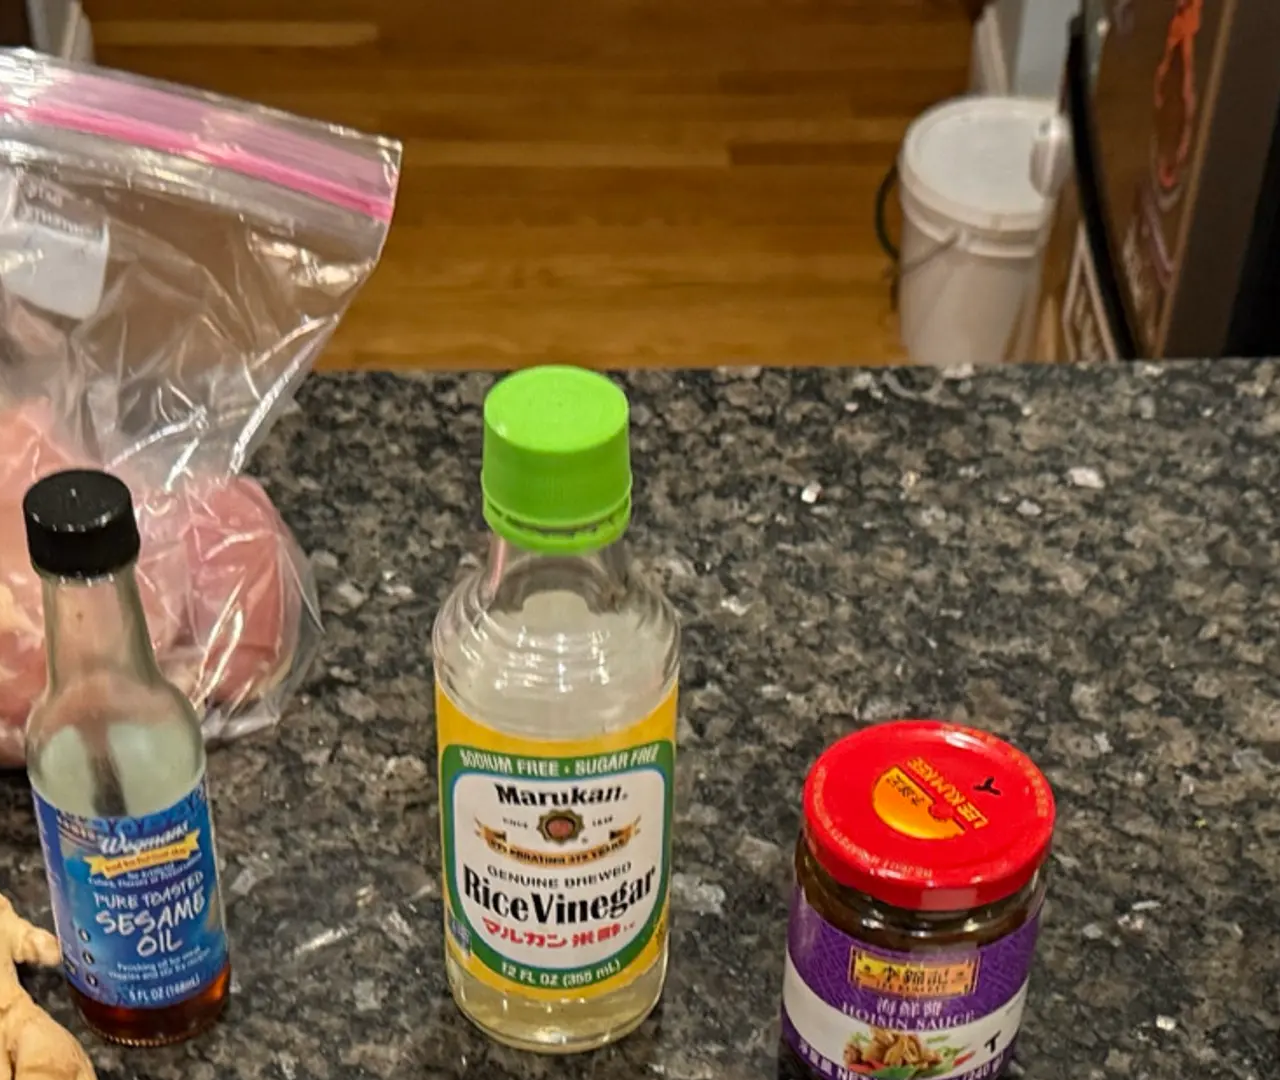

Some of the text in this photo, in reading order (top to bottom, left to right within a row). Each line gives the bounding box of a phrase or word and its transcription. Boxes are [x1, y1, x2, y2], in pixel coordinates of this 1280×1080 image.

[459, 744, 661, 777] SODIUM FREE SUGAR FREE
[99, 819, 189, 855] Wegmans
[93, 871, 203, 910] PURE TOASTED
[487, 861, 632, 889] GENUINE BREWED
[463, 863, 656, 925] Rice Vinegar
[95, 887, 205, 935] SESAME
[137, 929, 183, 957] OIL
[500, 960, 517, 977] 12
[518, 968, 537, 984] FL
[540, 972, 558, 987] OZ
[150, 985, 164, 1001] OZ
[842, 1001, 976, 1031] HOISIN SAUCE
